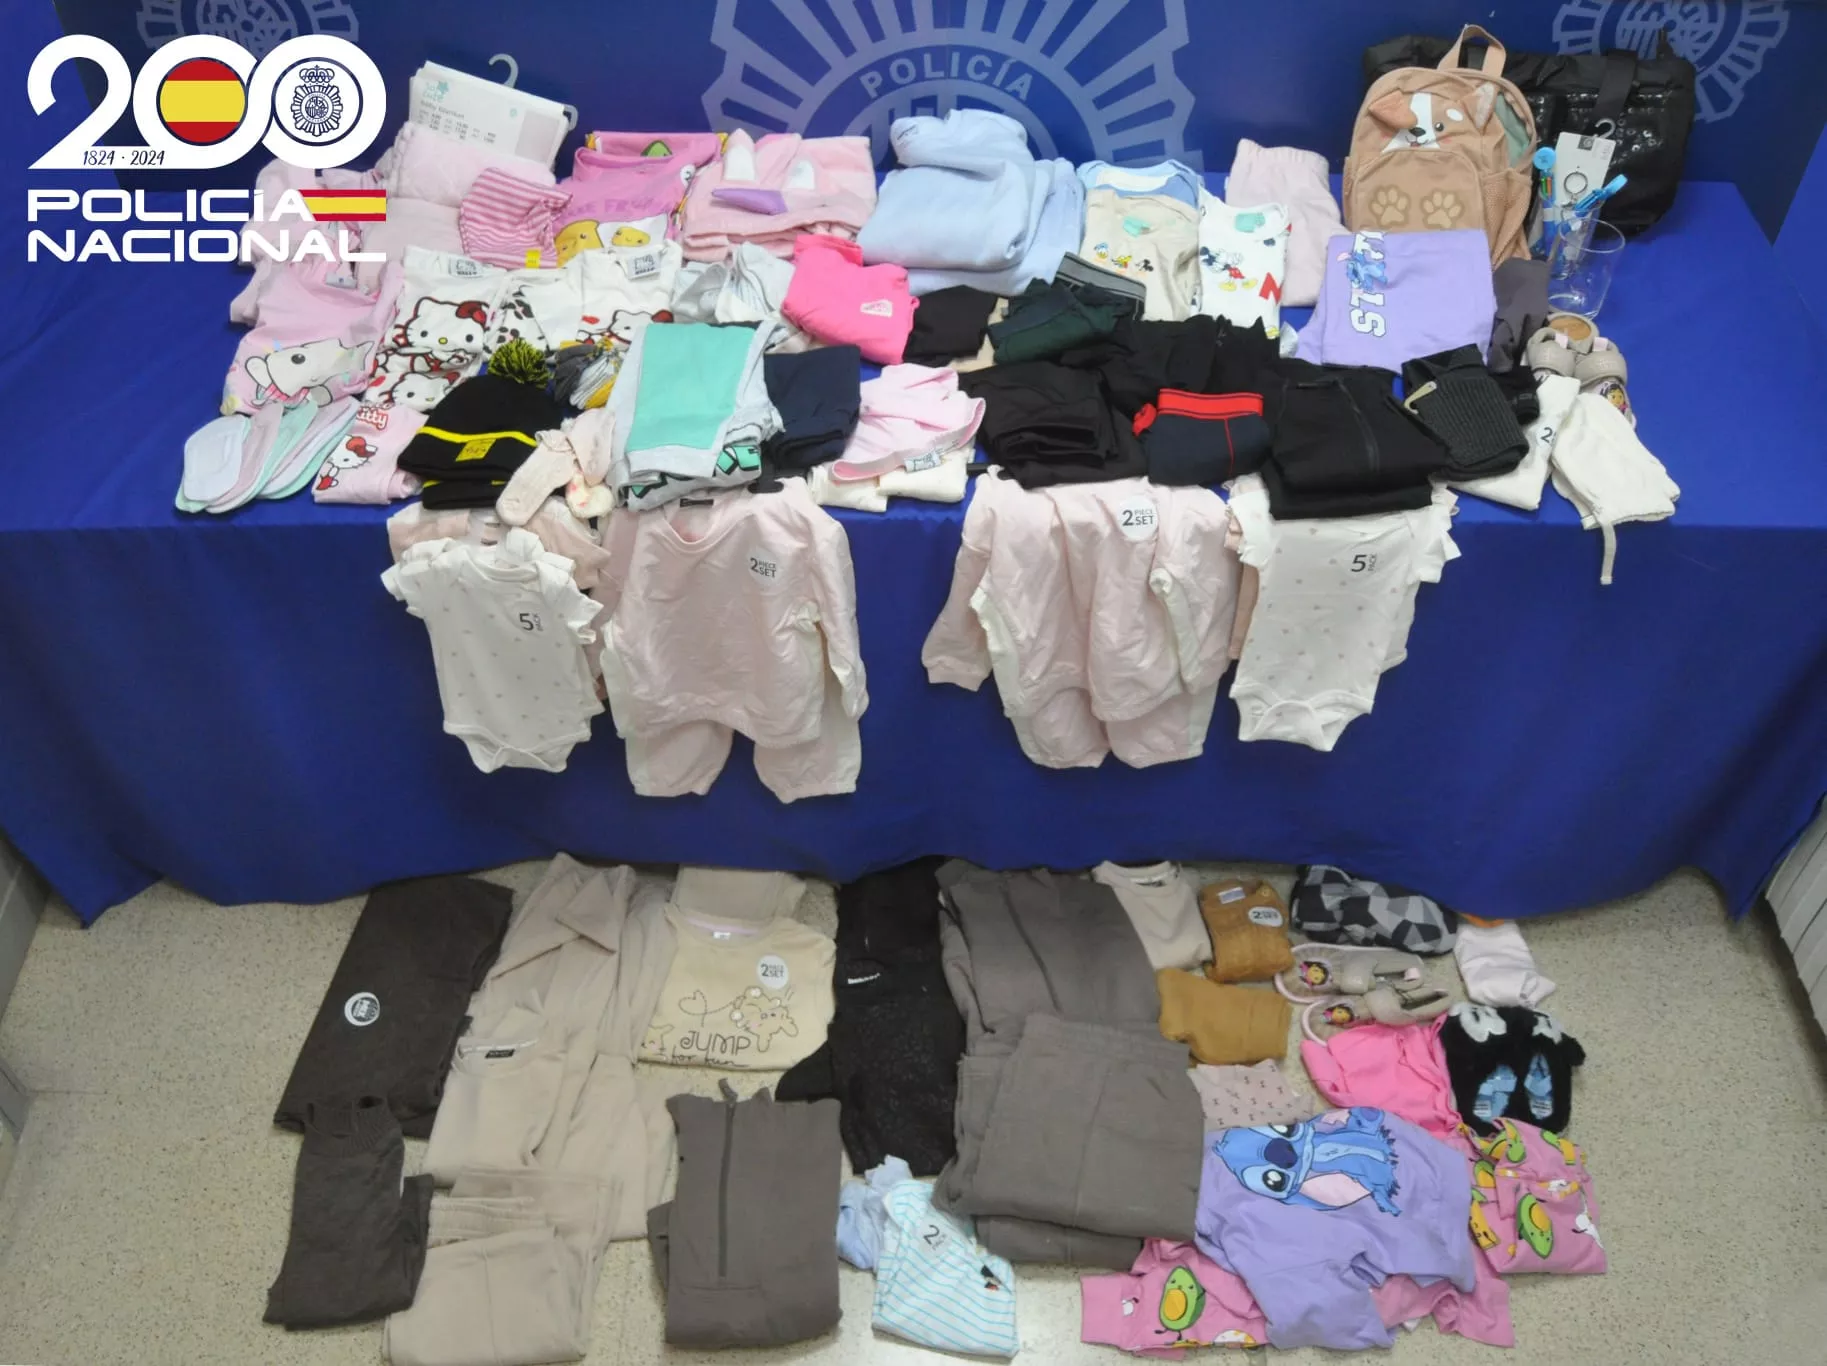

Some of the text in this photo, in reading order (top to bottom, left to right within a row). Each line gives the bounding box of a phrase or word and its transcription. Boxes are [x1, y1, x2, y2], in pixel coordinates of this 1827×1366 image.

[1540, 426, 1553, 444] 2
[1122, 509, 1134, 527] 2
[1135, 515, 1154, 526] SET
[750, 557, 759, 573] 2
[1351, 554, 1366, 572] 5
[759, 567, 777, 579] SET
[519, 612, 534, 631] 5
[761, 963, 769, 977] 2
[679, 1030, 751, 1055] JUMP
[923, 1224, 940, 1245] 2
